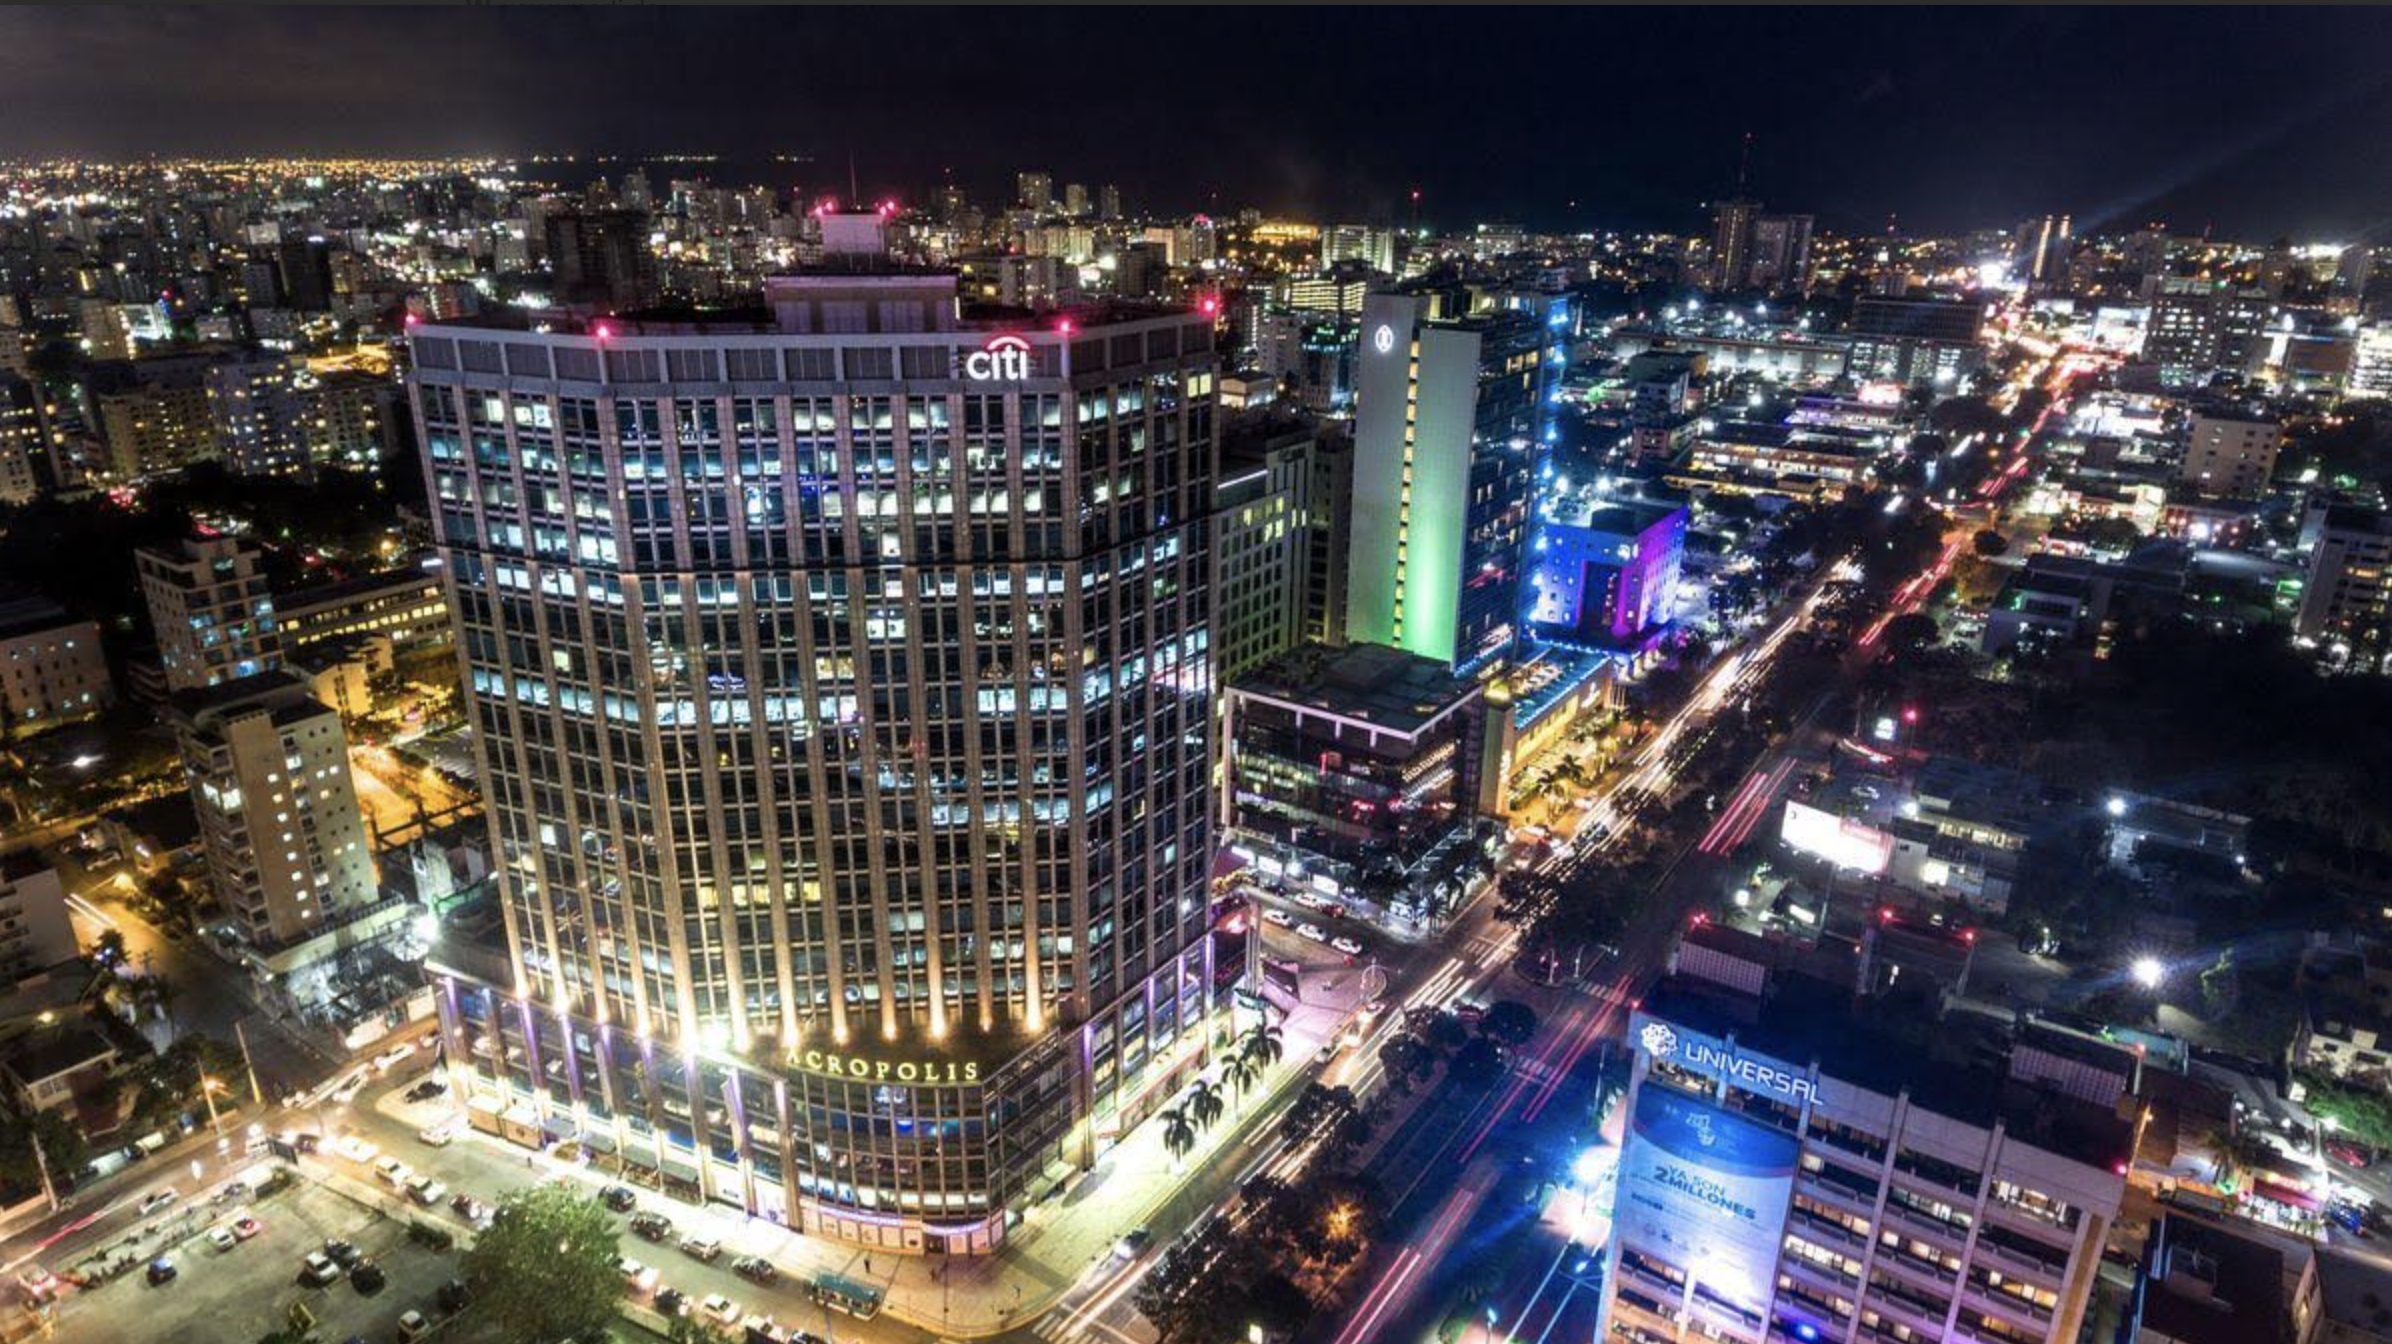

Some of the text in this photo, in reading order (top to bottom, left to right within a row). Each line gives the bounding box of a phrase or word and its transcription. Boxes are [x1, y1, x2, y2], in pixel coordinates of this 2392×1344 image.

[966, 344, 1028, 380] citi
[785, 1050, 978, 1081] ACROPOLIS
[1685, 1042, 1824, 1106] UNIVERSAL
[1668, 1164, 1688, 1181] YA
[1692, 1175, 1726, 1197] SON
